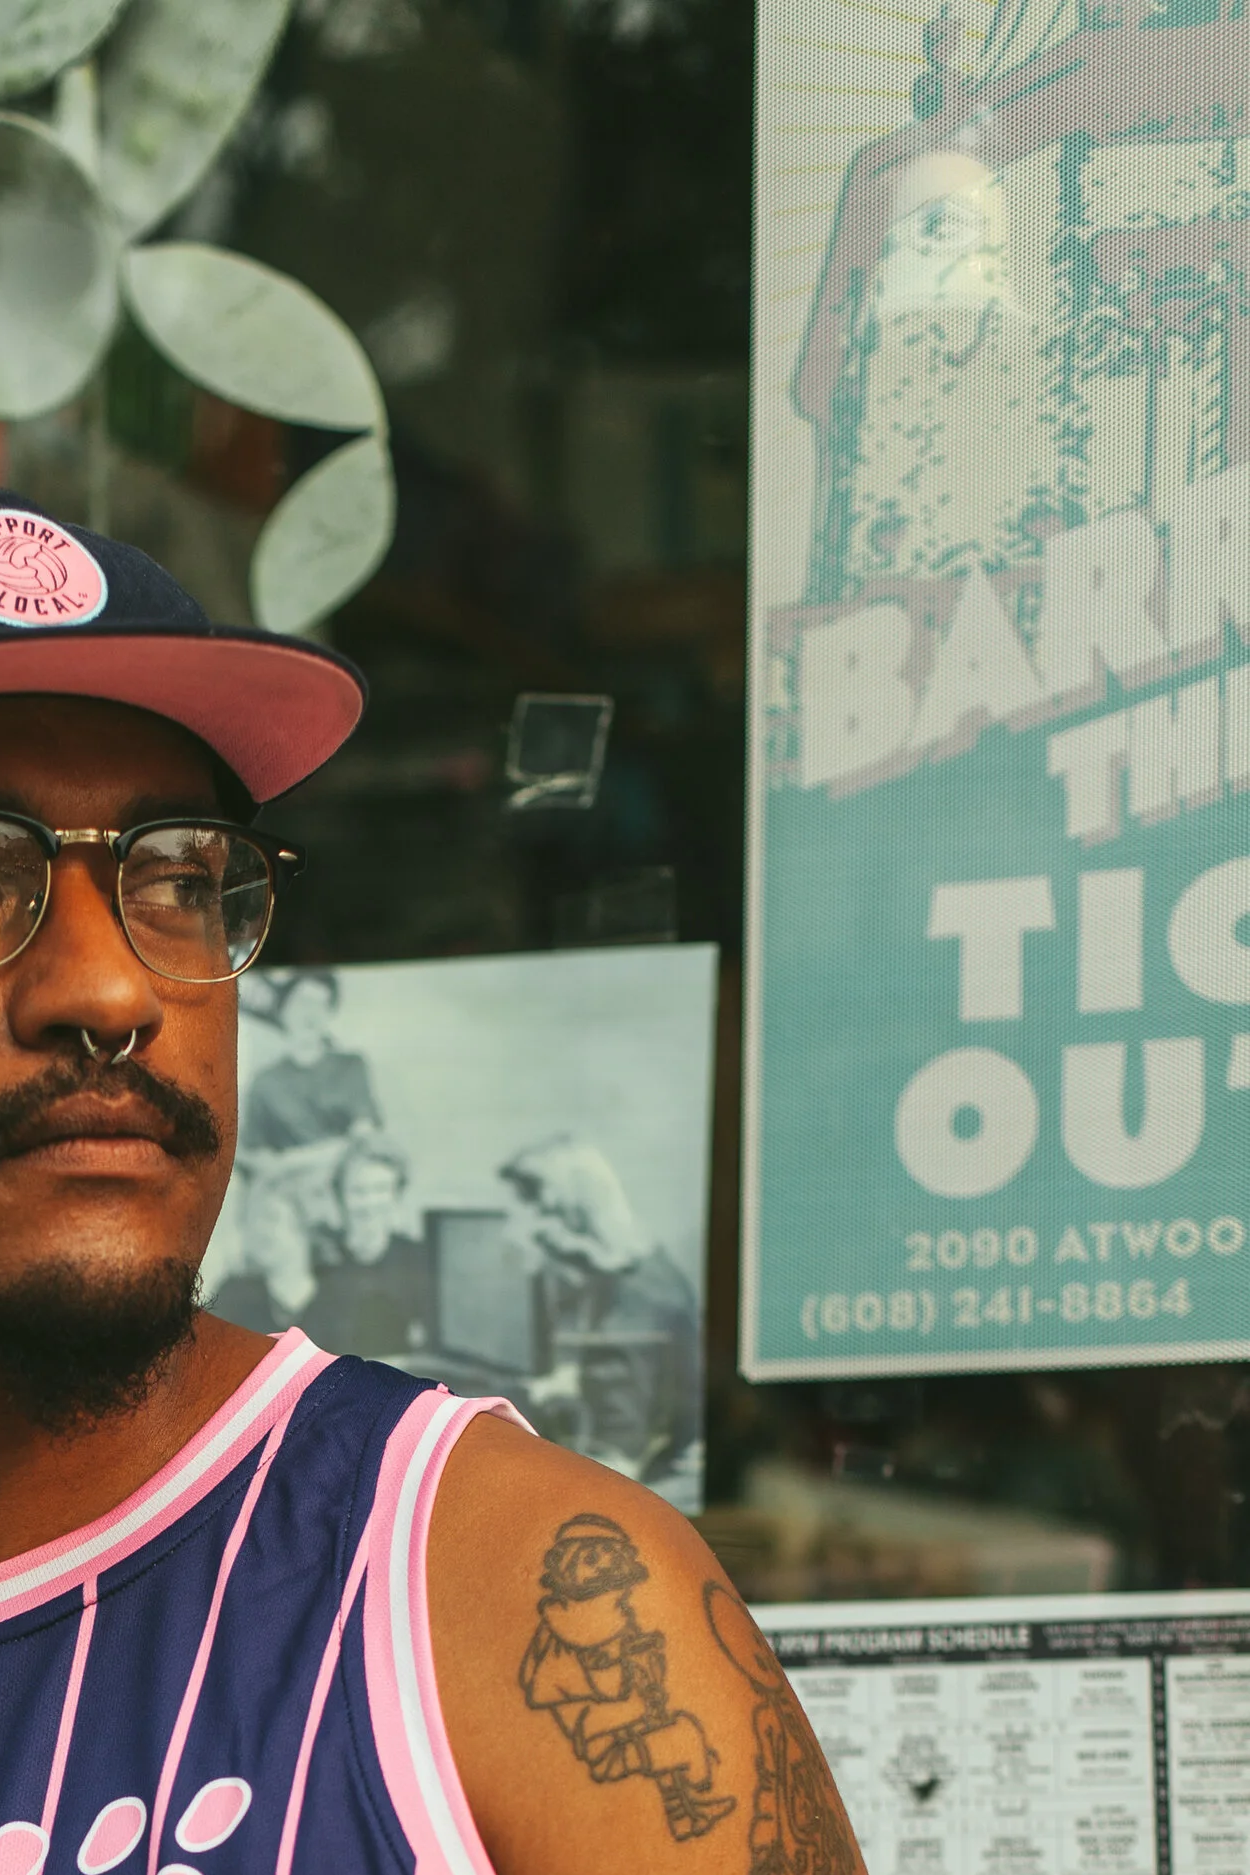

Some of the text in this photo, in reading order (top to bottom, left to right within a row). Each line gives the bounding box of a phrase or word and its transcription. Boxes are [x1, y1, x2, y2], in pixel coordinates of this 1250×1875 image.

[894, 1032, 1250, 1200] OU
[904, 1215, 1246, 1272] 2090 ATWOO
[801, 1277, 1191, 1341] (608) 241-8864
[928, 1623, 1032, 1650] SCHEDULE
